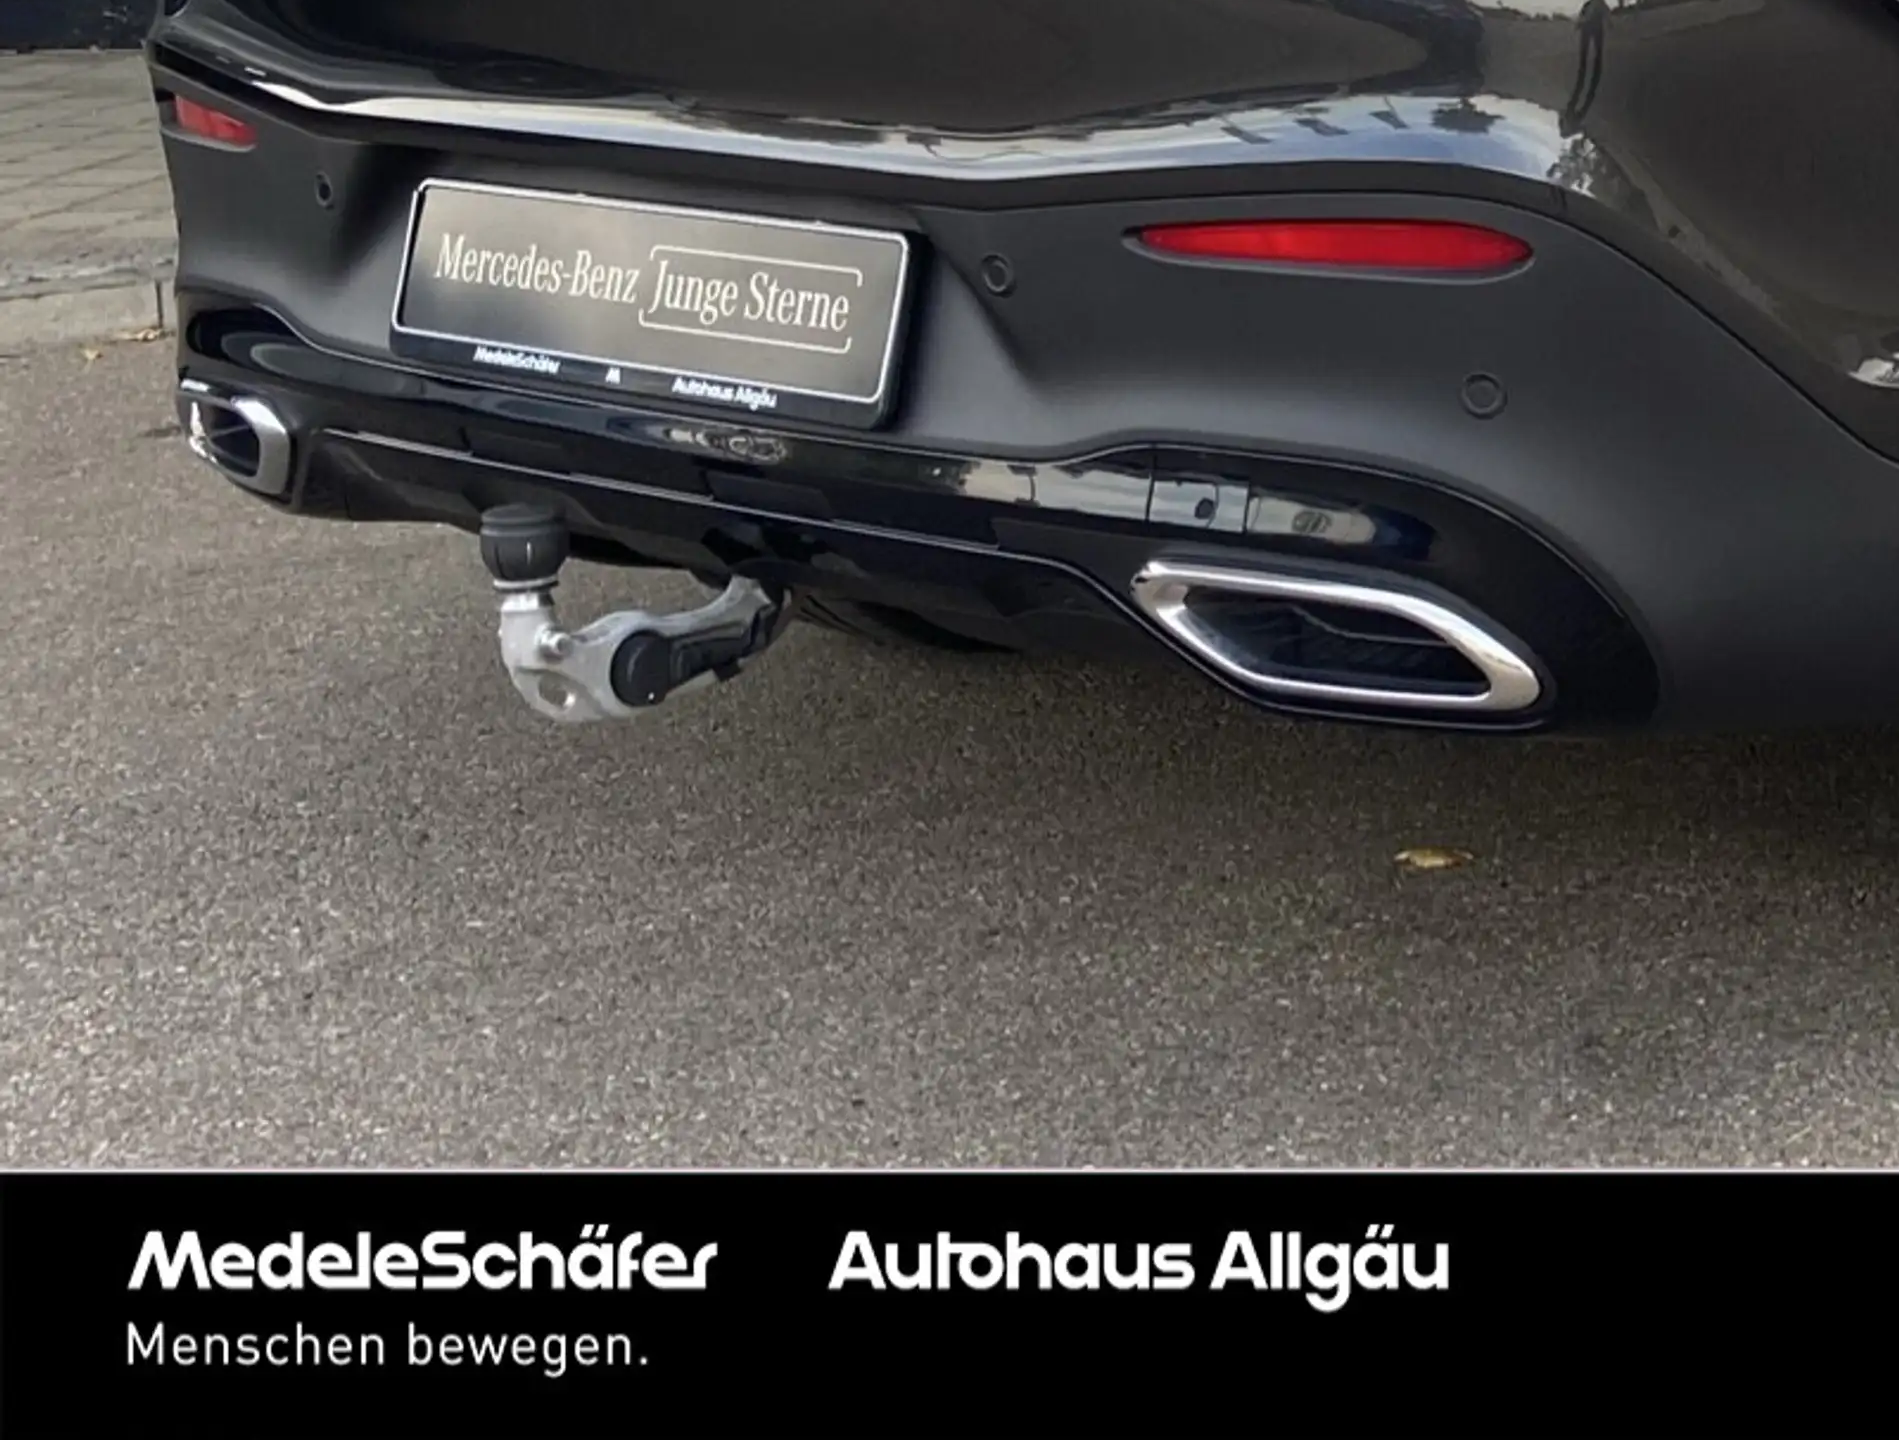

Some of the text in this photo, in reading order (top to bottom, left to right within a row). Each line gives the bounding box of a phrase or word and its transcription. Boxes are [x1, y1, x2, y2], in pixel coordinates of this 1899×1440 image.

[434, 233, 849, 332] Mercedes-Benz Junge Sterne
